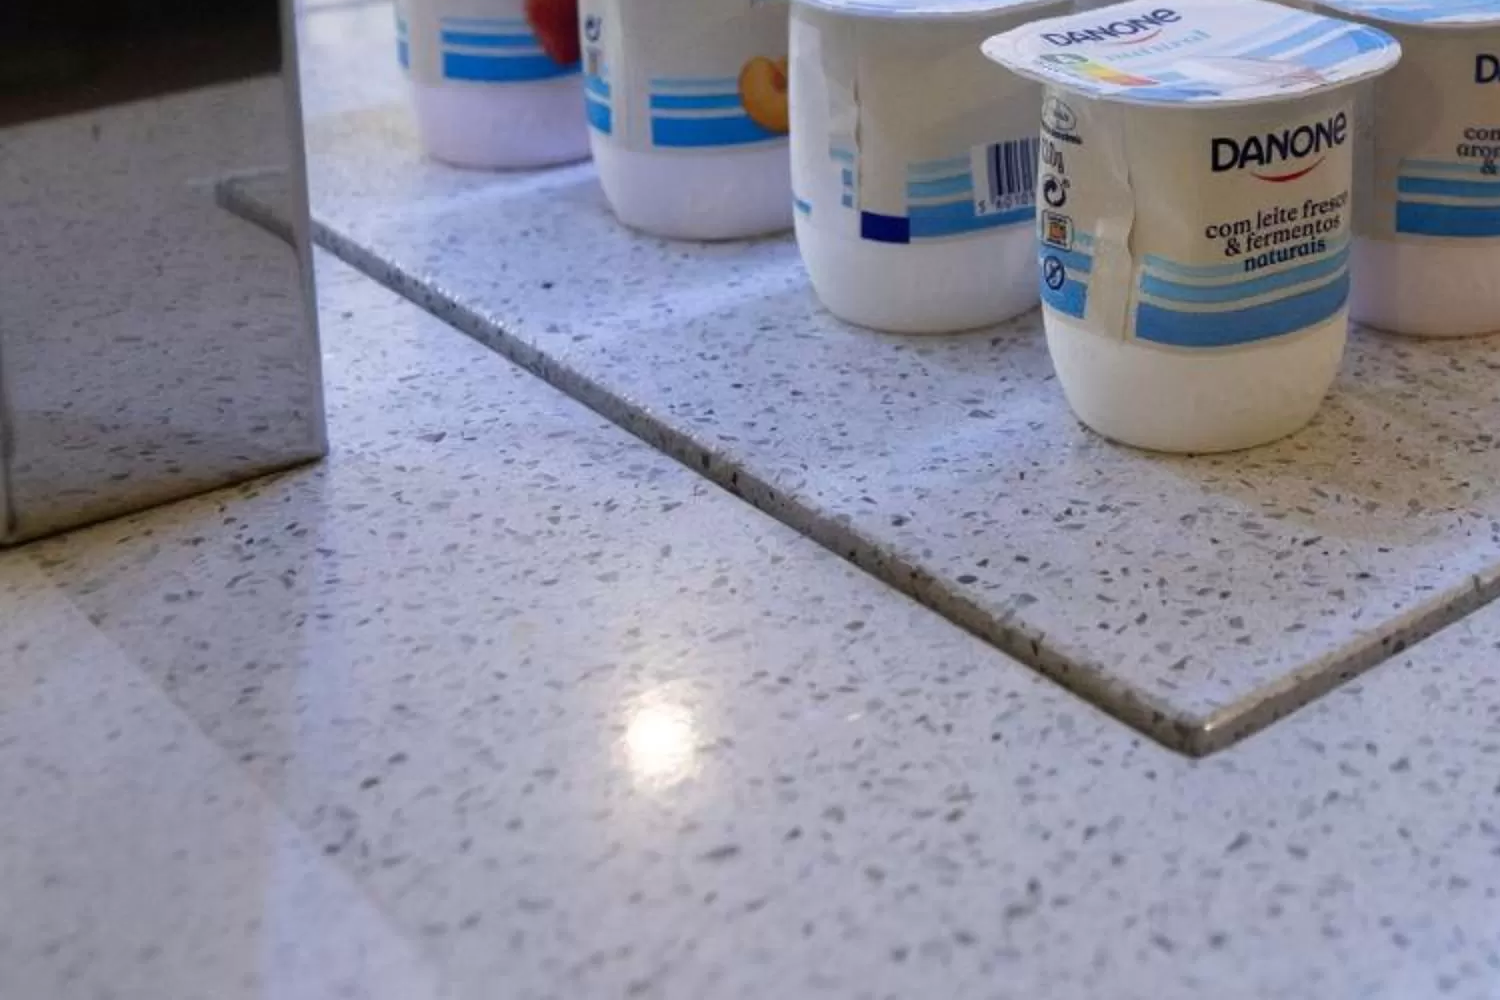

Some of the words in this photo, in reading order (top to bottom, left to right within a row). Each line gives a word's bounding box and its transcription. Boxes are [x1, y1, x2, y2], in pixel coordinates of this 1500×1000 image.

[1205, 217, 1251, 240] com
[1257, 206, 1299, 230] leite
[1224, 236, 1243, 258] &
[1246, 213, 1342, 252] fermentos
[1243, 236, 1327, 273] naturais
